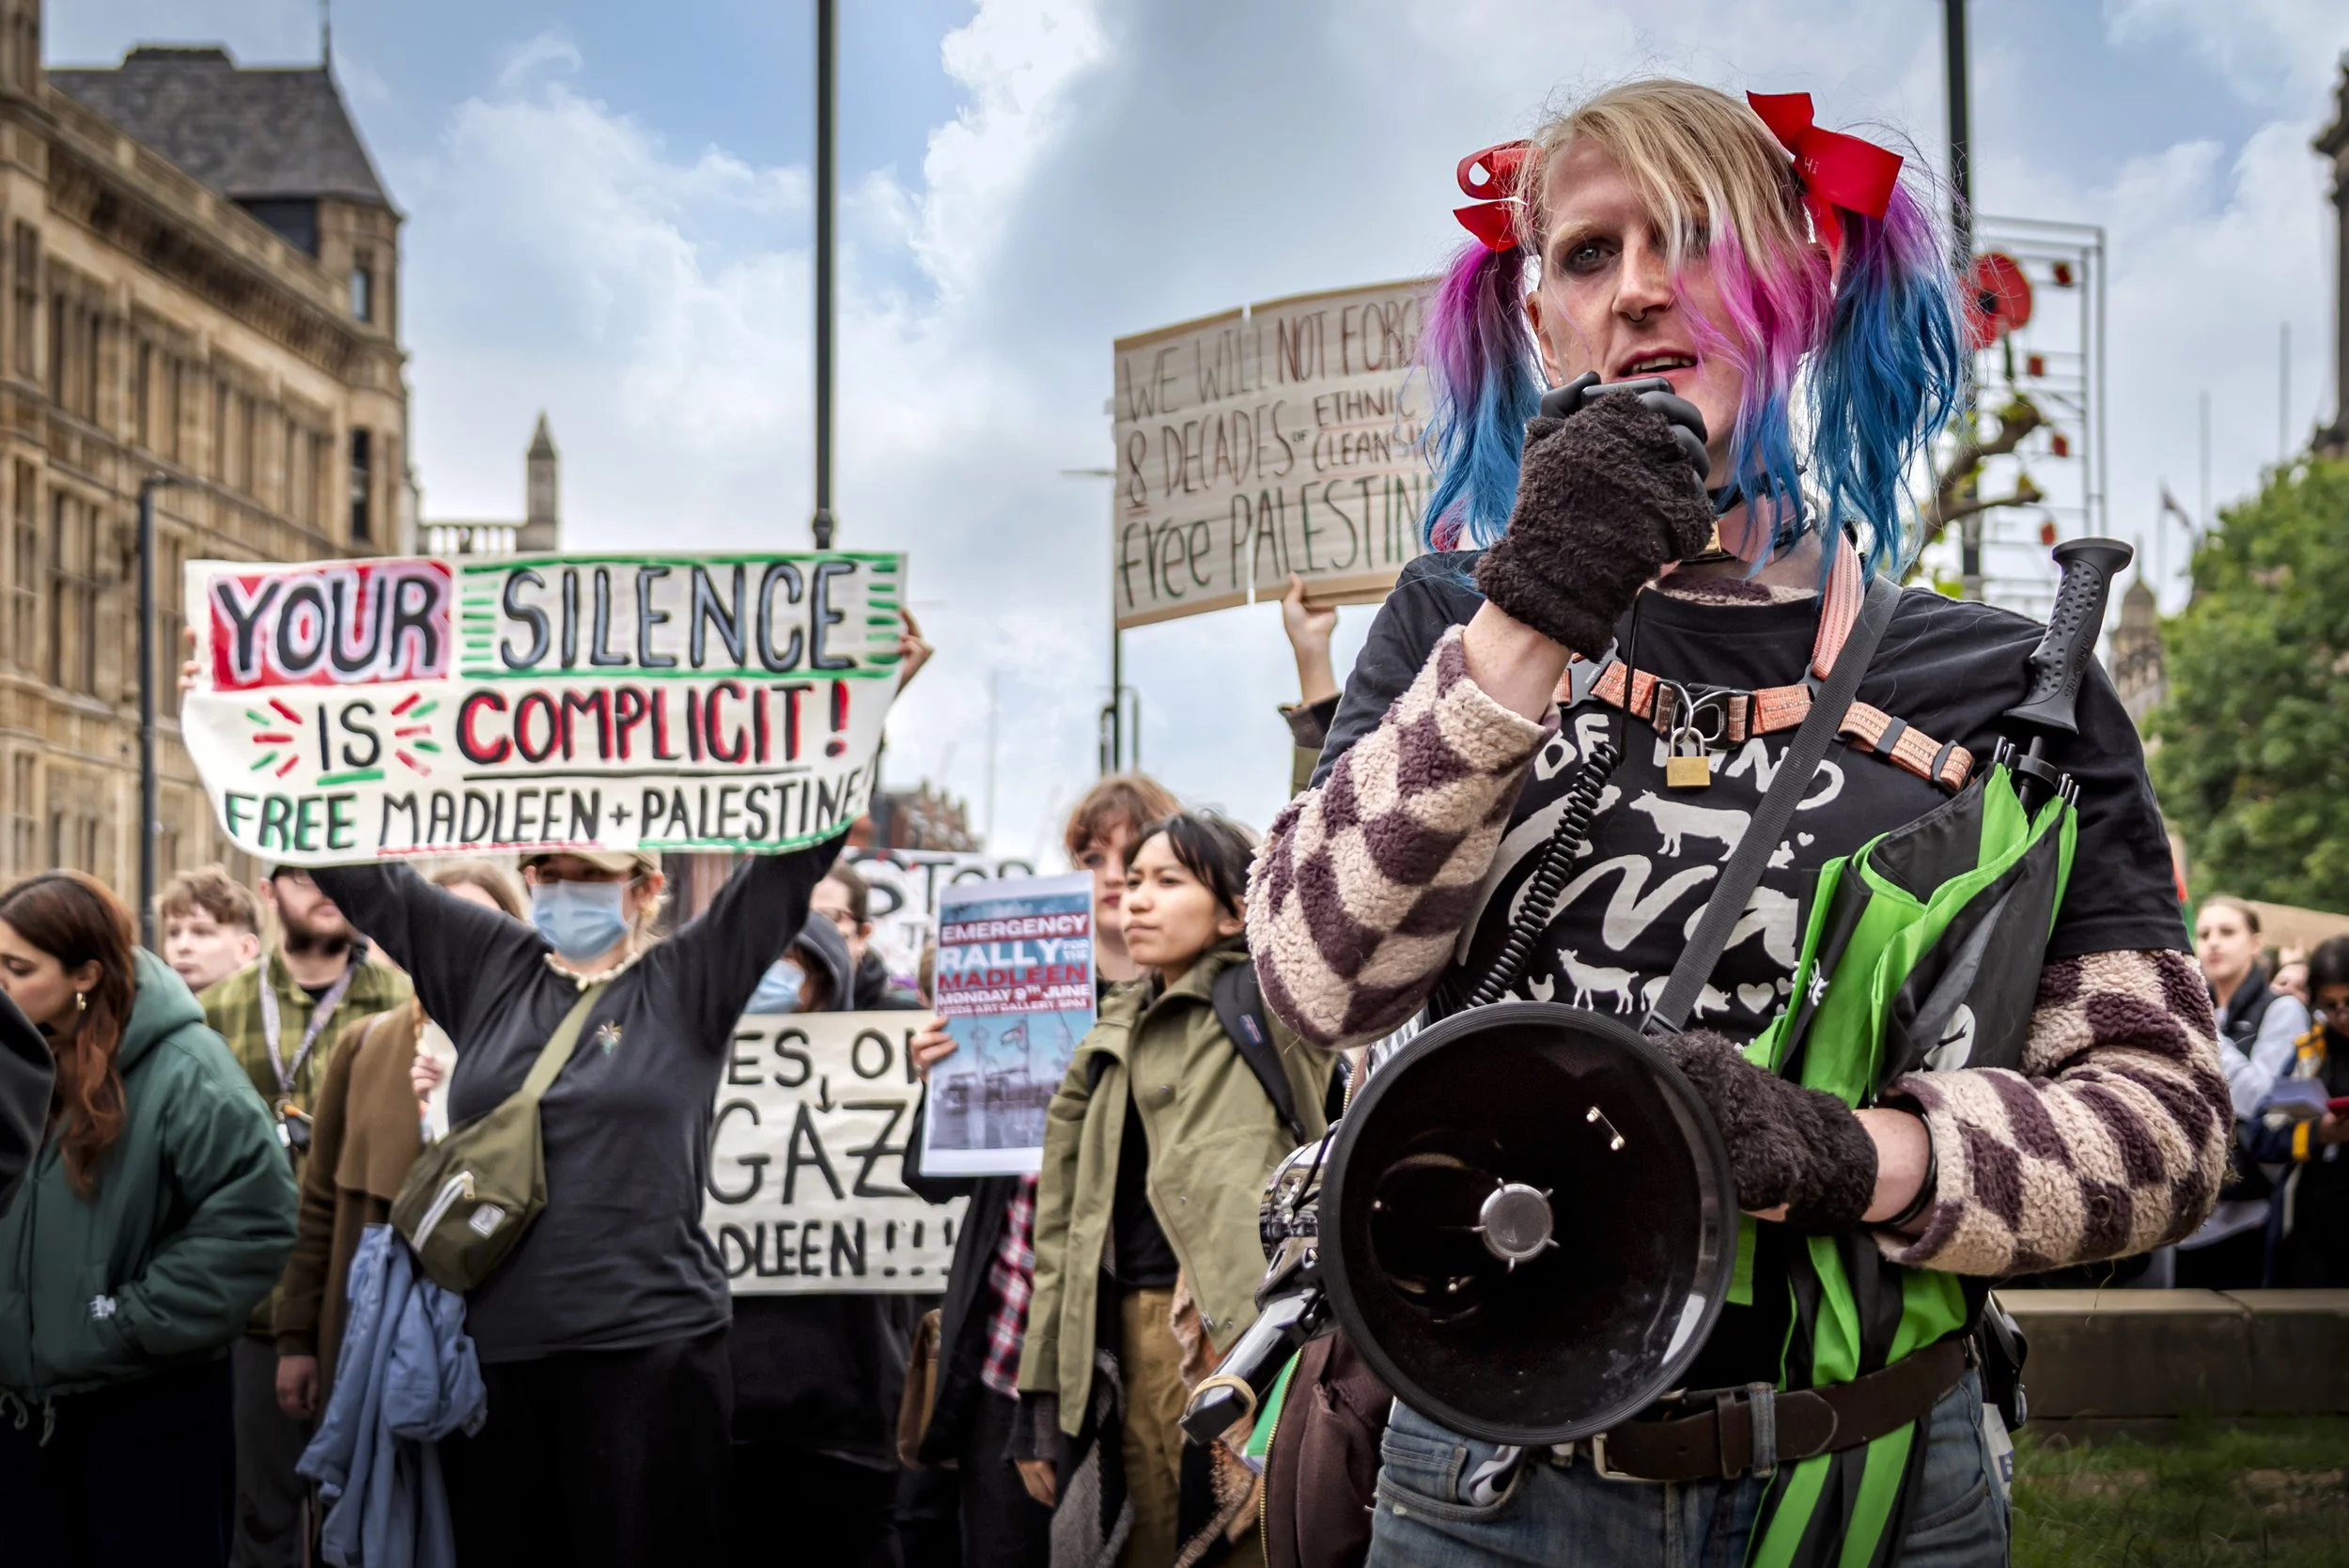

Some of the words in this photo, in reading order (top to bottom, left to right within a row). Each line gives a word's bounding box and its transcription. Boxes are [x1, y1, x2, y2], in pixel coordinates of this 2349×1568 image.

[1125, 347, 1179, 422] WE
[1196, 324, 1268, 404] WILL
[1277, 310, 1329, 384] NOT
[1340, 295, 1434, 376] FORG
[1315, 386, 1417, 427] ETHNIC
[1128, 429, 1148, 505] 8
[1161, 400, 1295, 496] DECADES
[1230, 474, 1435, 589] PALESTIN
[215, 575, 443, 677] YOUR
[501, 562, 858, 672] SILENCE
[317, 700, 380, 769] IS
[225, 789, 358, 850] FREE
[939, 938, 1064, 970] RALLY
[941, 913, 1088, 942] EMERGENCY
[939, 963, 1087, 990] MADLEEN
[939, 988, 1011, 1005] MONDAY
[1043, 984, 1091, 999] JUNE
[974, 1002, 998, 1013] ART
[1002, 1000, 1054, 1011] GALLERY
[1058, 998, 1086, 1008] 5PM
[727, 1026, 814, 1088] ES
[707, 1096, 916, 1205] GAZ
